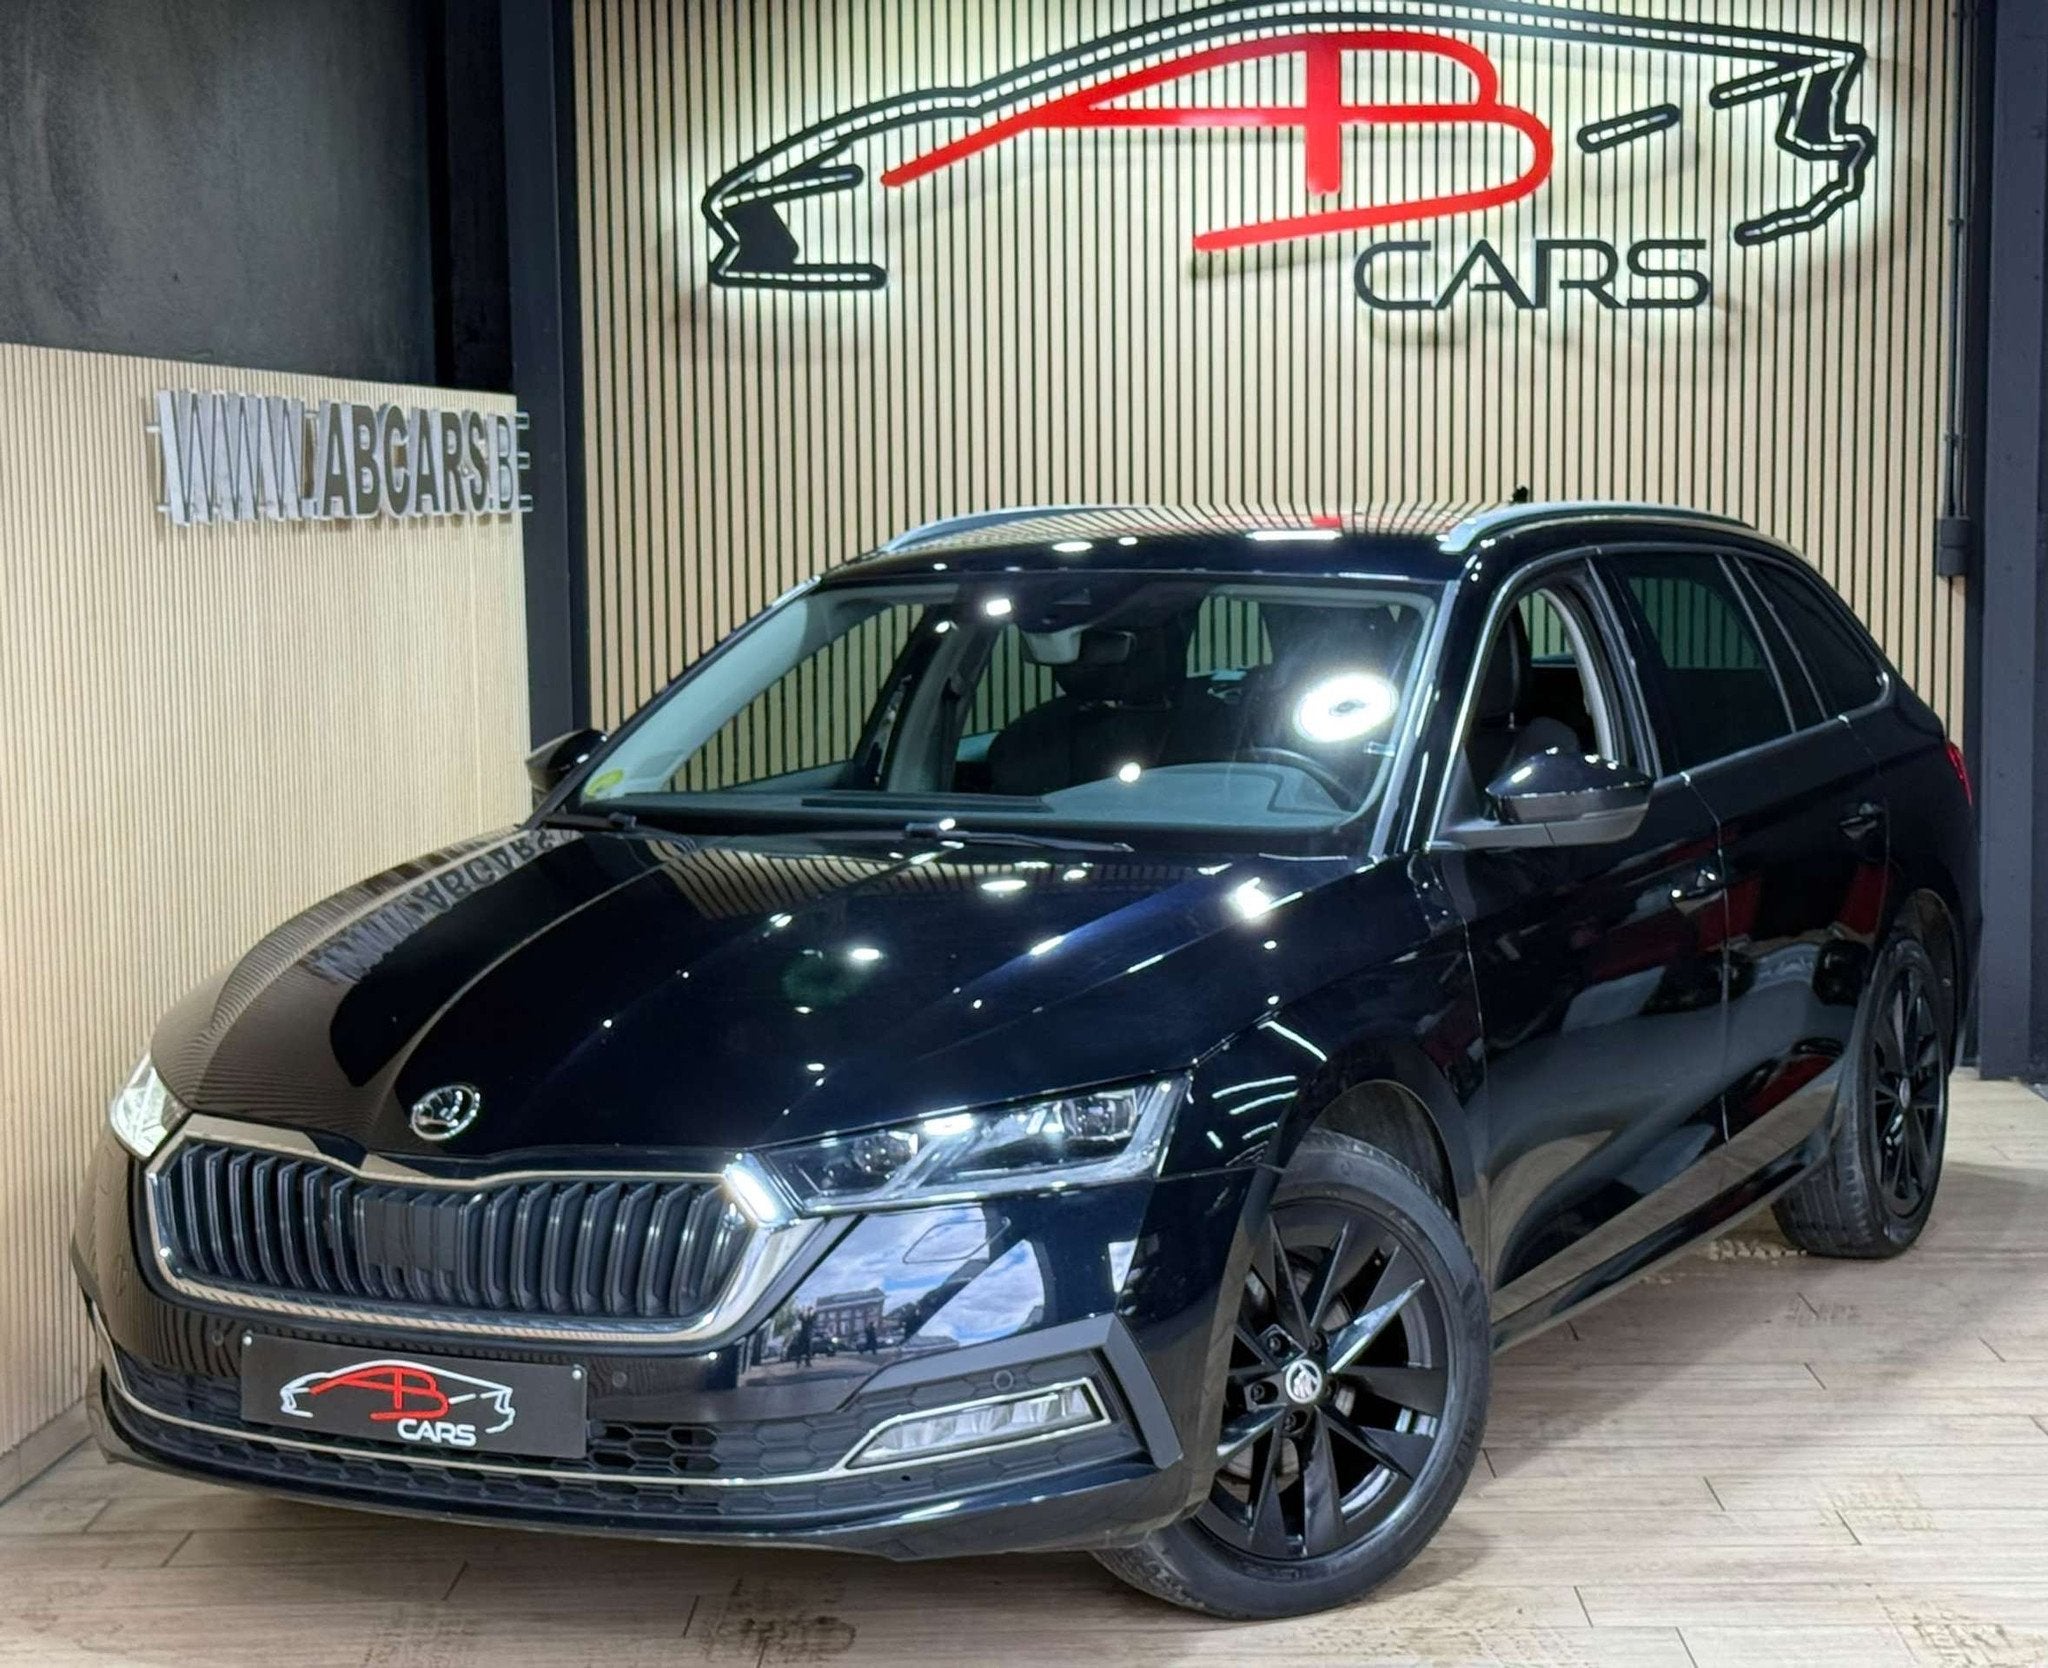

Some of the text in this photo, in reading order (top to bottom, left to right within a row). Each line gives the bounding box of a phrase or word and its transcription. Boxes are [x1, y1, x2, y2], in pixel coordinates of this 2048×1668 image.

[1353, 238, 1711, 310] CARS
[156, 388, 533, 526] WWW.ABCARS.BE
[397, 1418, 477, 1447] CARS
